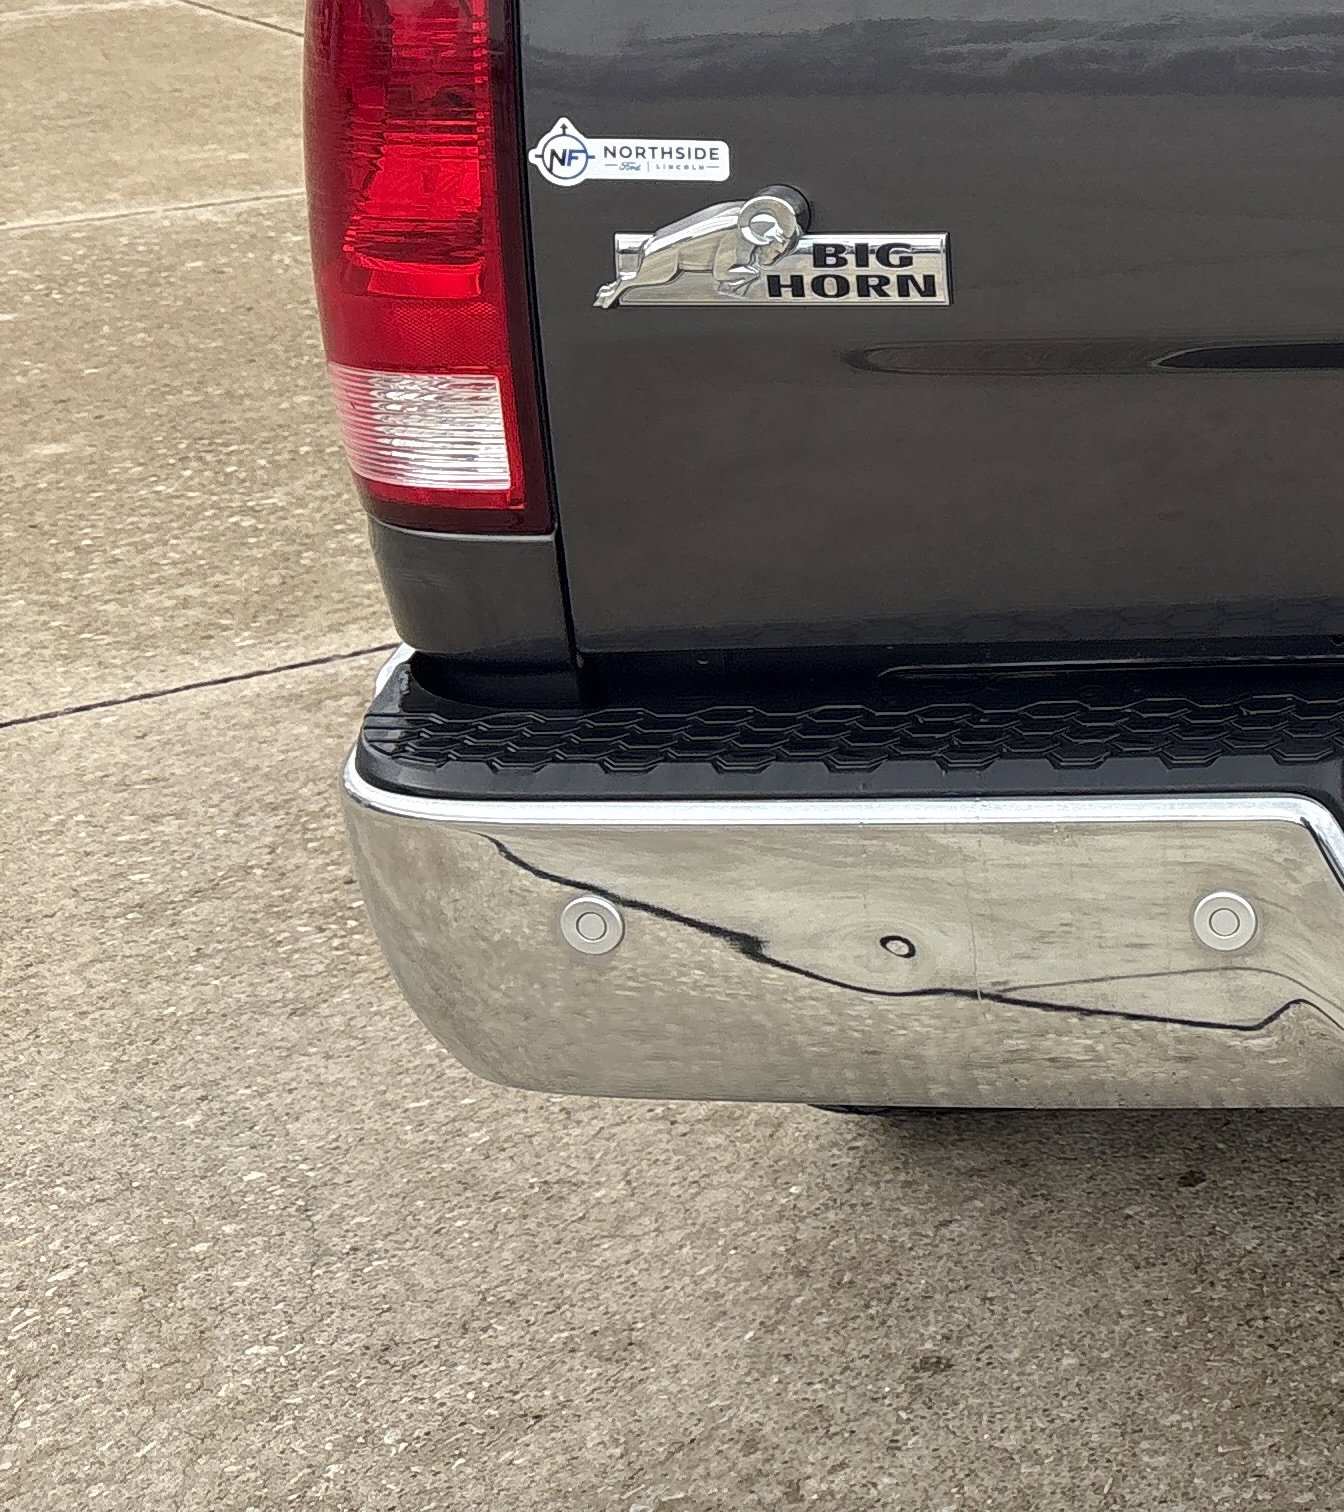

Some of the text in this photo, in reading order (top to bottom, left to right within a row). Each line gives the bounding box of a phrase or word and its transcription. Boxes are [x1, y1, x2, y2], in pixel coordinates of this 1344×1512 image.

[549, 148, 587, 172] NF
[603, 145, 720, 161] NORTHSIDE
[812, 242, 914, 269] BIG
[767, 273, 937, 298] HORN
